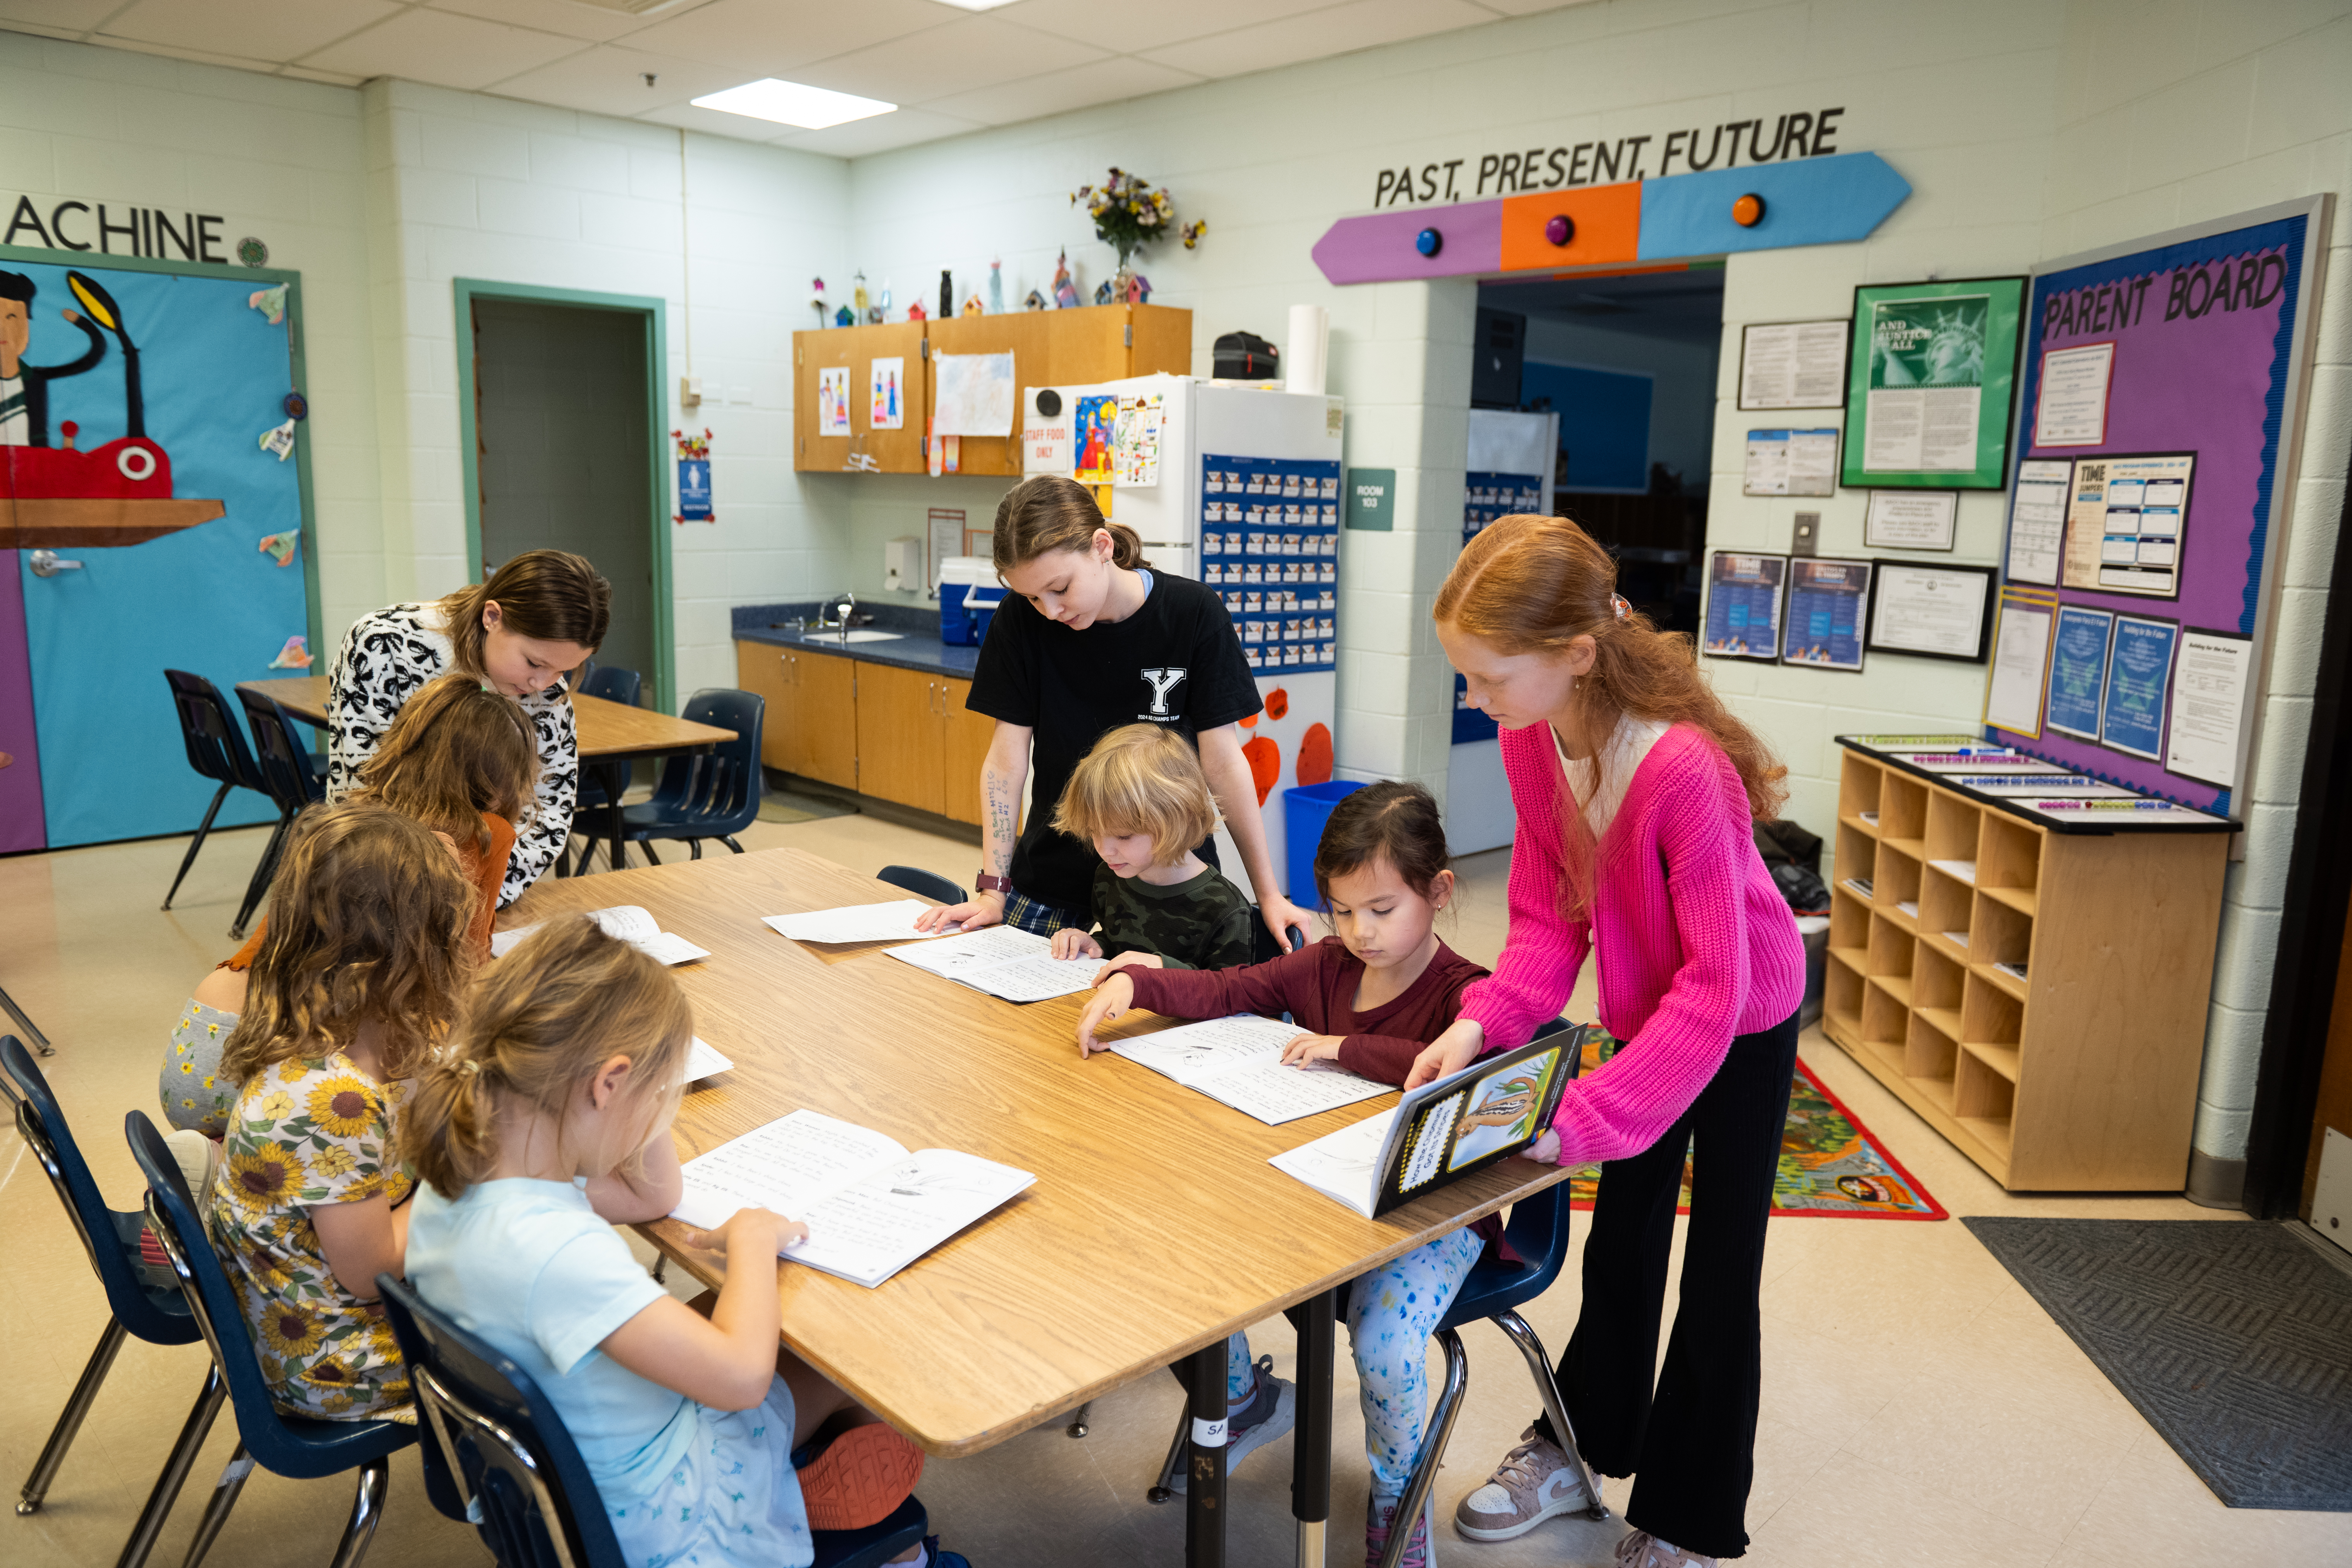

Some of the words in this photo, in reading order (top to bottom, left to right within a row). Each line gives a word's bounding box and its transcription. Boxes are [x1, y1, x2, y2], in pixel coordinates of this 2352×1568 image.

[1375, 158, 1464, 208] PAST,
[1476, 134, 1652, 195] PRESENT,
[1659, 107, 1845, 176] FUTURE
[2042, 277, 2153, 341] PARENT
[2165, 253, 2288, 322] BOARD
[1878, 320, 1907, 330] AND
[1877, 328, 1932, 341] JUSTICE
[1891, 340, 1915, 351] ALL
[1025, 428, 1044, 442] STAFF
[1046, 427, 1065, 440] FOOD
[1036, 446, 1053, 458] ONLY
[2081, 464, 2106, 482] TIME
[1357, 485, 1384, 497] ROOM
[2079, 484, 2104, 492] JUMPERS
[1362, 497, 1377, 509] 103
[2189, 643, 2205, 651] Building
[2222, 646, 2238, 655] Future
[1141, 667, 1187, 715] Y
[1434, 1109, 1451, 1140] Stripes
[1410, 1164, 1421, 1184] How
[1418, 1147, 1427, 1163] the
[1423, 1105, 1445, 1147] Chipmunk
[1430, 1139, 1439, 1151] Its
[1424, 1150, 1435, 1169] Got
